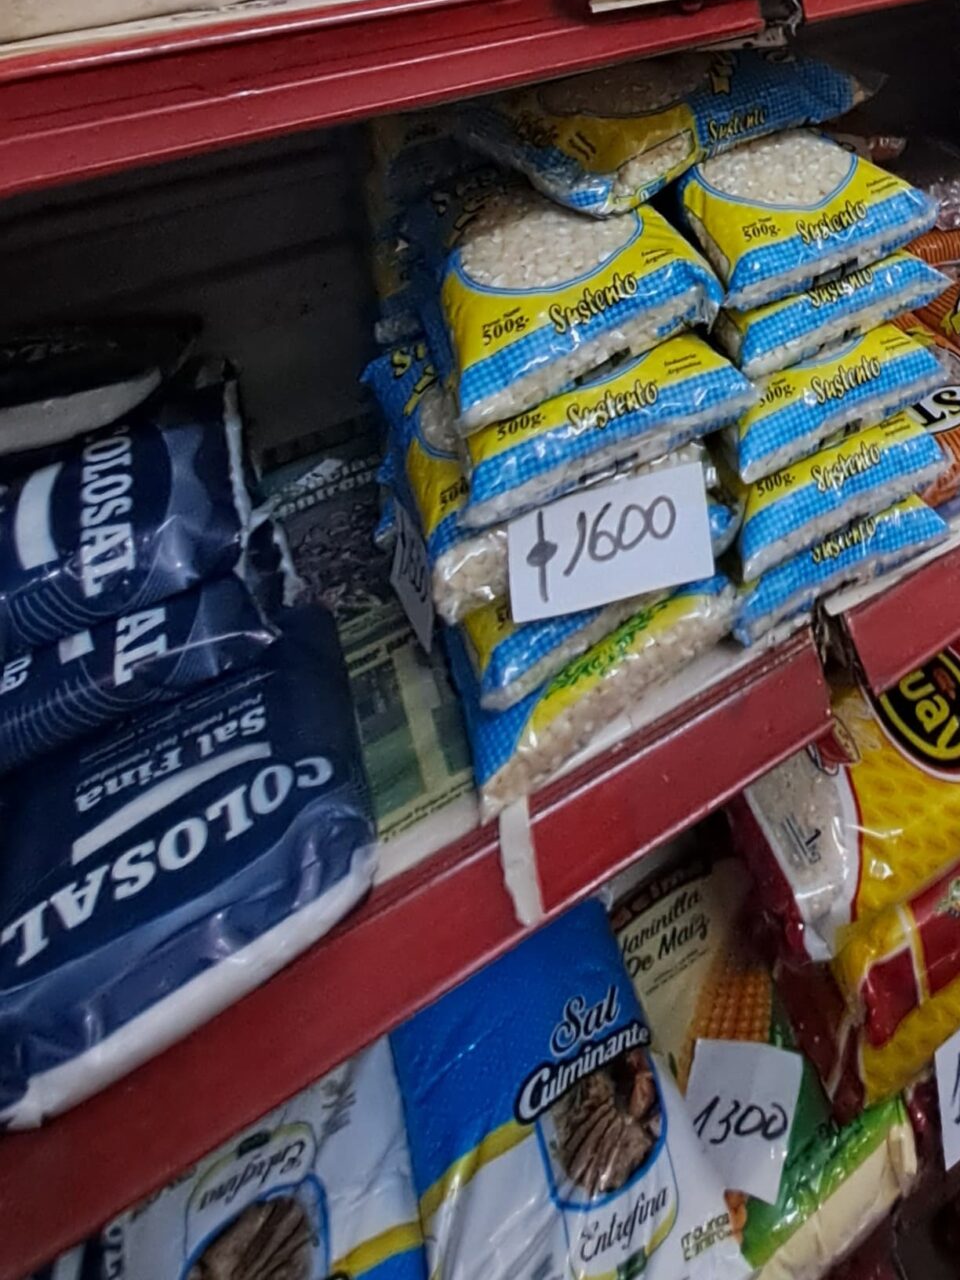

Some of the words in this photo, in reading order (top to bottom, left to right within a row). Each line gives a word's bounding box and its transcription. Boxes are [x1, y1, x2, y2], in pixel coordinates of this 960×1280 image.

[795, 199, 868, 245] Sustento
[549, 271, 638, 335] Sustento
[566, 379, 659, 434] Sustento
[810, 356, 881, 405] Sustento
[810, 441, 881, 493] Sustento
[525, 494, 677, 604] $1600
[195, 705, 266, 758] Sal
[75, 746, 184, 813] Fina
[0, 755, 334, 967] COLOSAL
[550, 984, 621, 1058] Sal
[517, 1024, 650, 1121] Culminante
[692, 1095, 789, 1145] 1300
